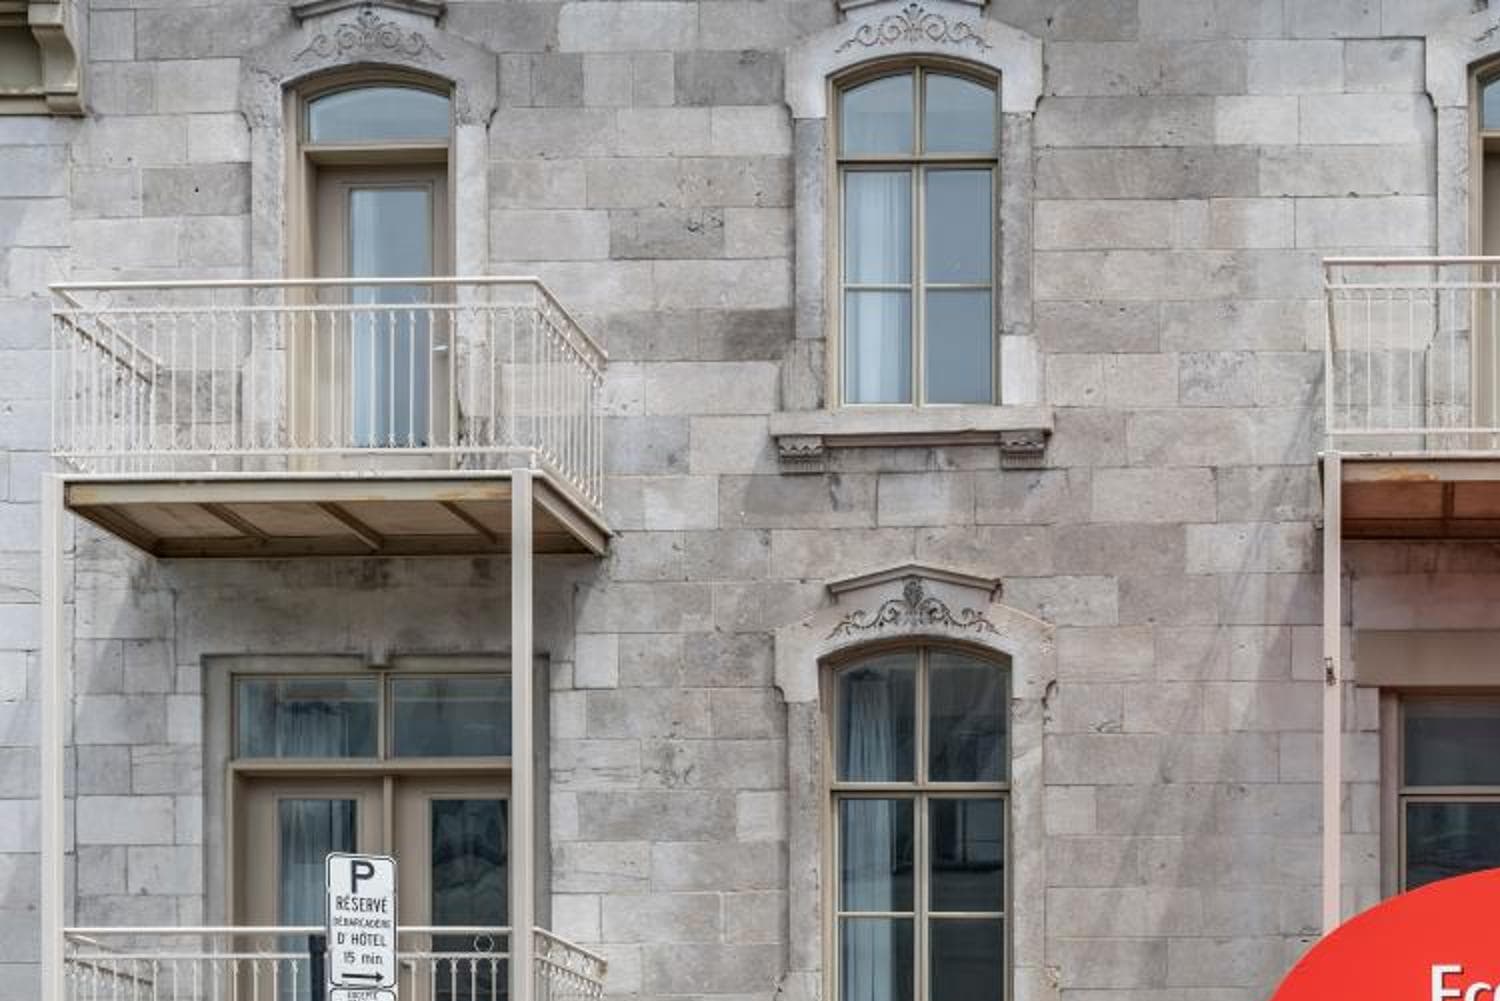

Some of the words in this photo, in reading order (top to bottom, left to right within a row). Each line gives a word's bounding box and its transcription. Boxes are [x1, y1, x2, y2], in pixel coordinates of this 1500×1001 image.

[351, 860, 375, 894] P
[335, 895, 387, 913] RÉSERVÉ
[343, 951, 356, 965] 15
